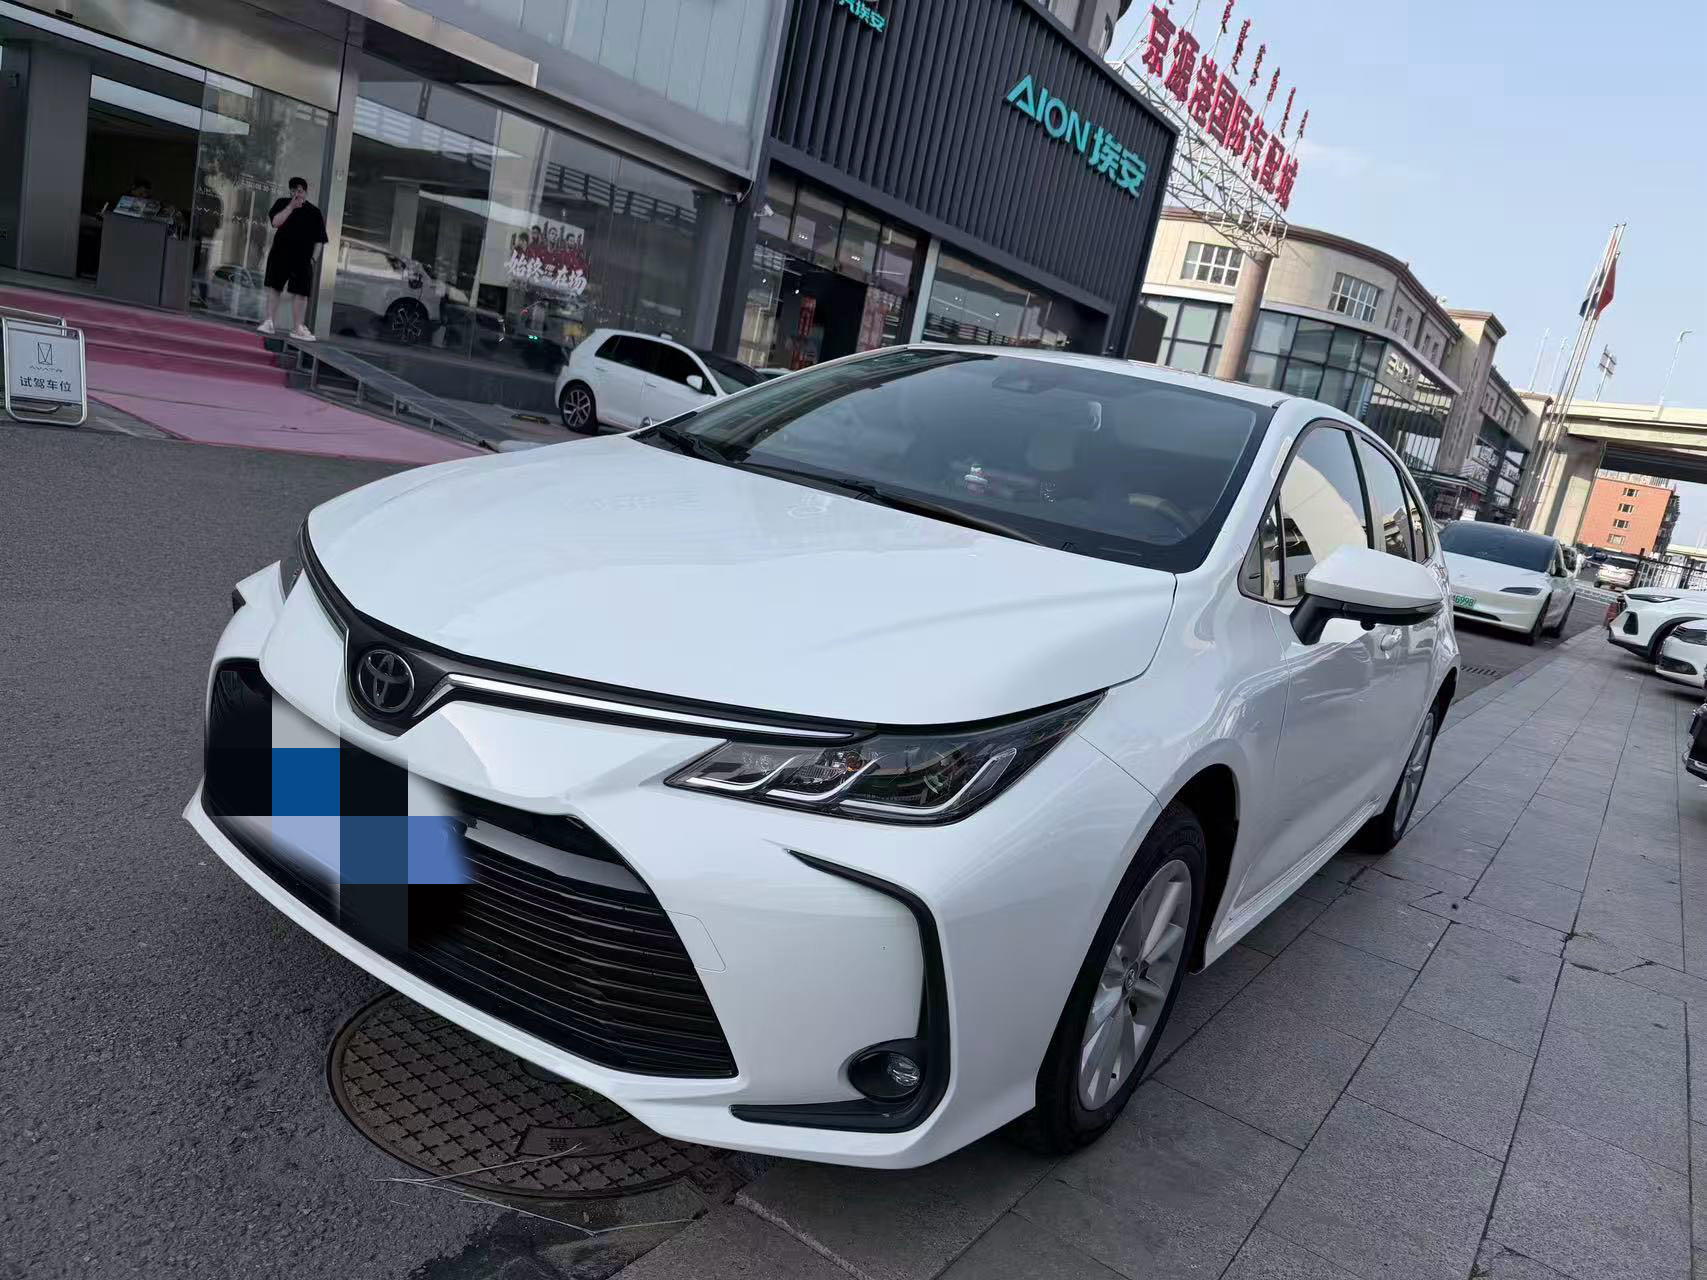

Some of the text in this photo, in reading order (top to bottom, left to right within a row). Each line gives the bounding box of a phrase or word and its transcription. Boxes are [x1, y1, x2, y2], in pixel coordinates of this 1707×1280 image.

[1141, 4, 1298, 212] 京源港国际汽配城
[20, 376, 72, 392] 试驾车位
